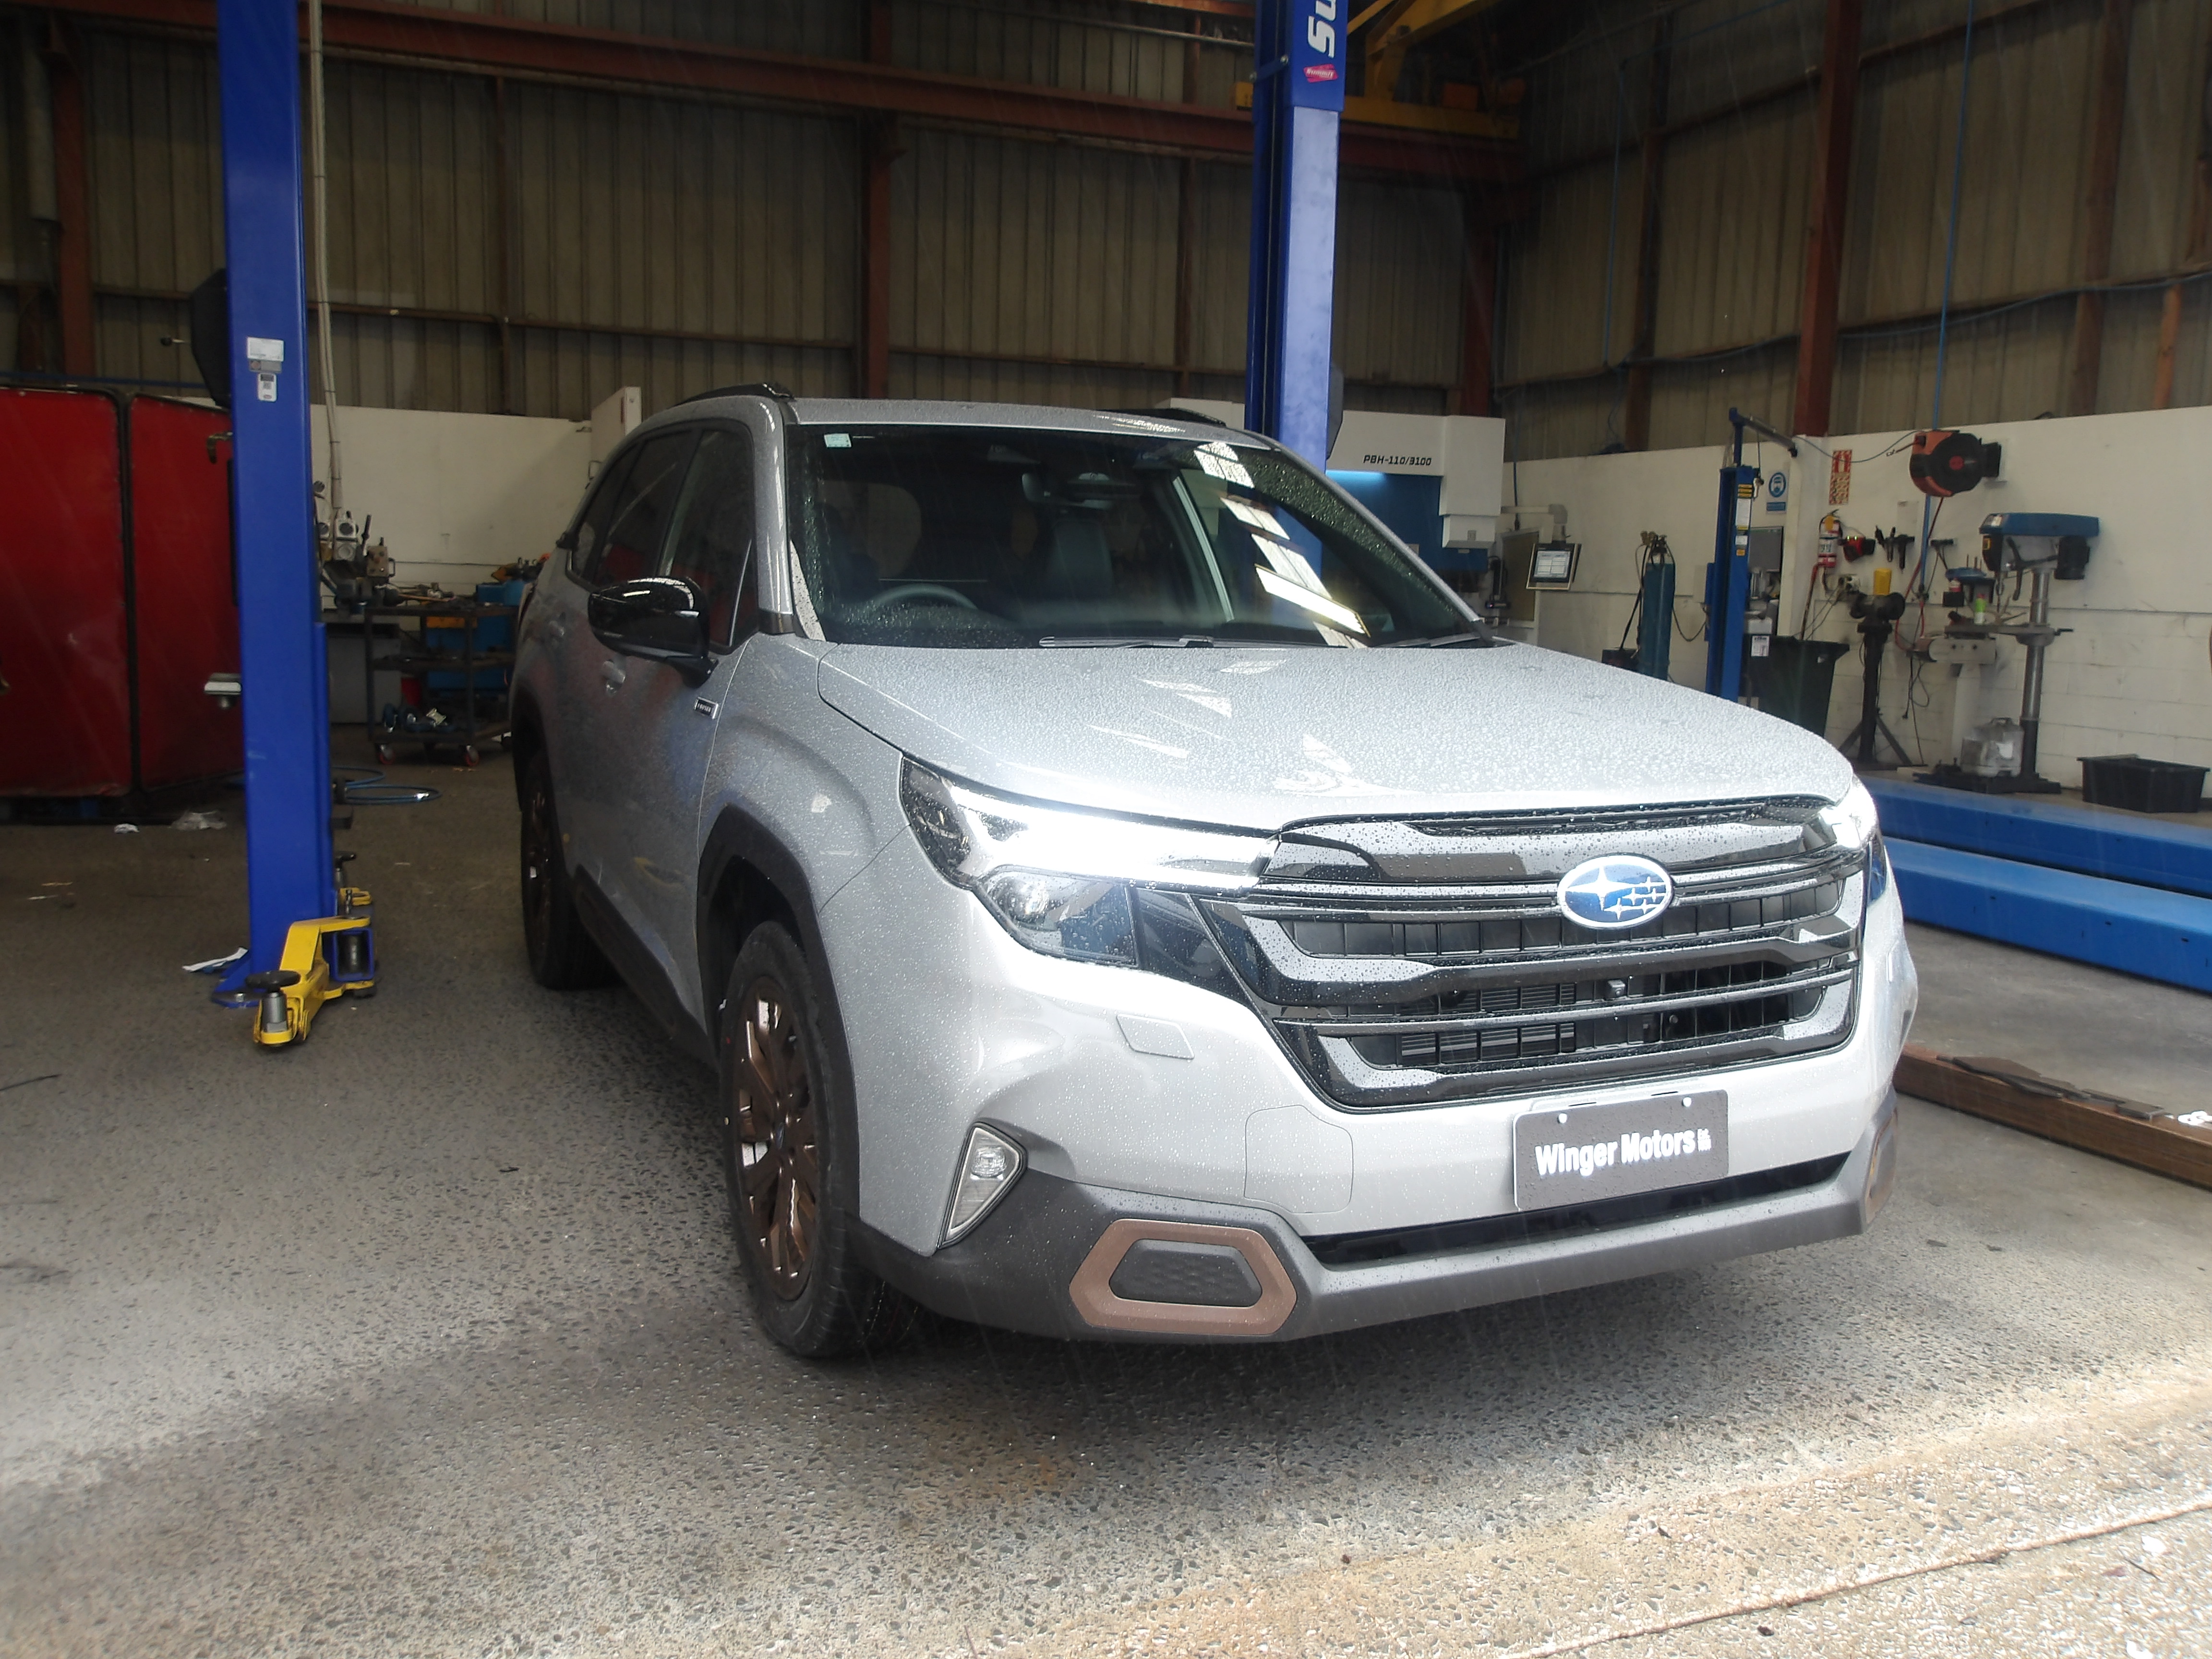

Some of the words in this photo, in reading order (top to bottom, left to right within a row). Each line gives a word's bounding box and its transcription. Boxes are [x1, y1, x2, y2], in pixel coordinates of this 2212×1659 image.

[1363, 455, 1432, 466] PBH-110/3100
[1535, 1141, 1618, 1177] Winger
[1621, 1130, 1696, 1164] Motors
